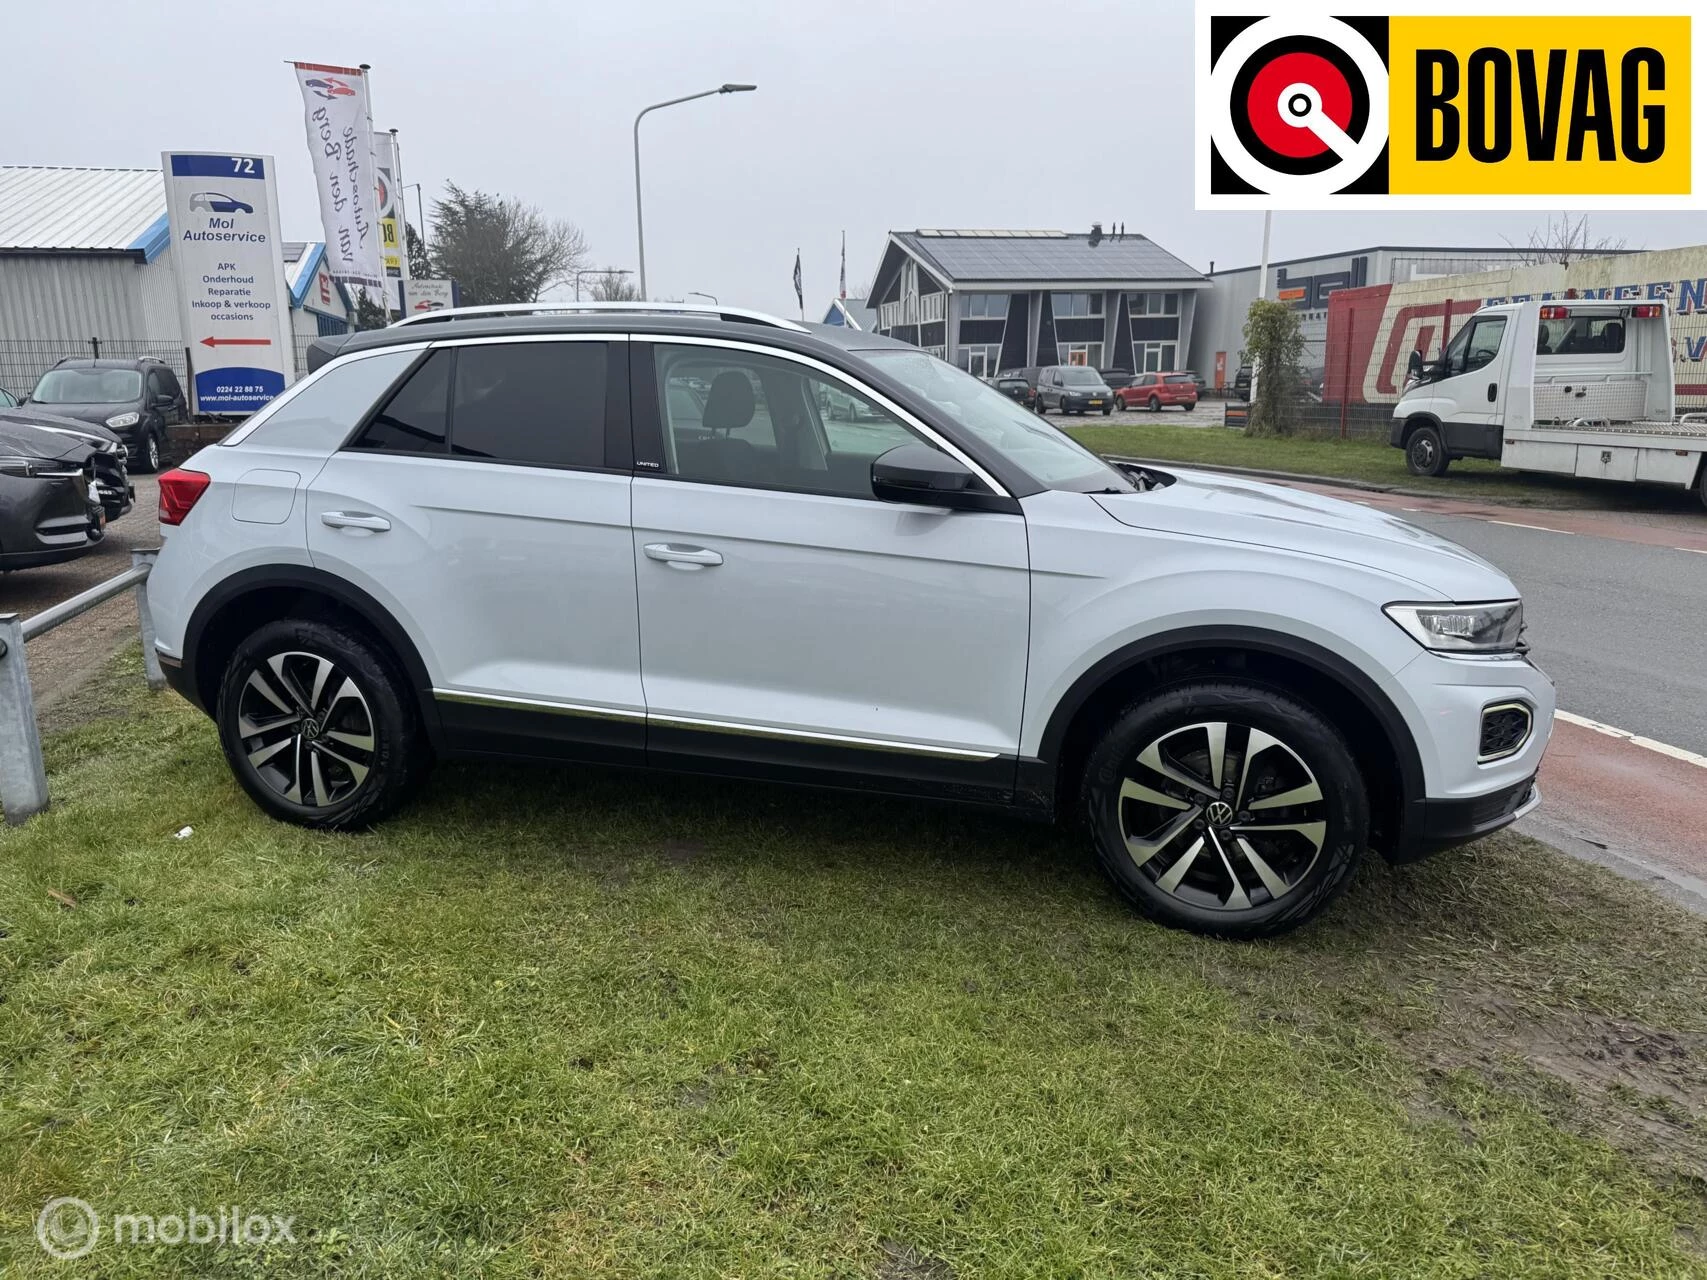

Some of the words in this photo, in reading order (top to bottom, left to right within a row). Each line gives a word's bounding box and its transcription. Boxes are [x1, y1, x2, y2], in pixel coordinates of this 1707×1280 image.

[231, 157, 255, 174] 72
[209, 217, 234, 229] Mol
[183, 229, 266, 243] Autoservice
[217, 262, 236, 271] APK
[202, 275, 254, 284] Onderhoud
[208, 287, 251, 296] Reparatie
[192, 300, 222, 309] Inkoop
[224, 300, 232, 308] &
[233, 301, 271, 310] verkoop
[210, 312, 254, 321] occasions
[216, 385, 233, 393] 0224
[234, 385, 243, 393] 22
[636, 460, 659, 468] UNITED
